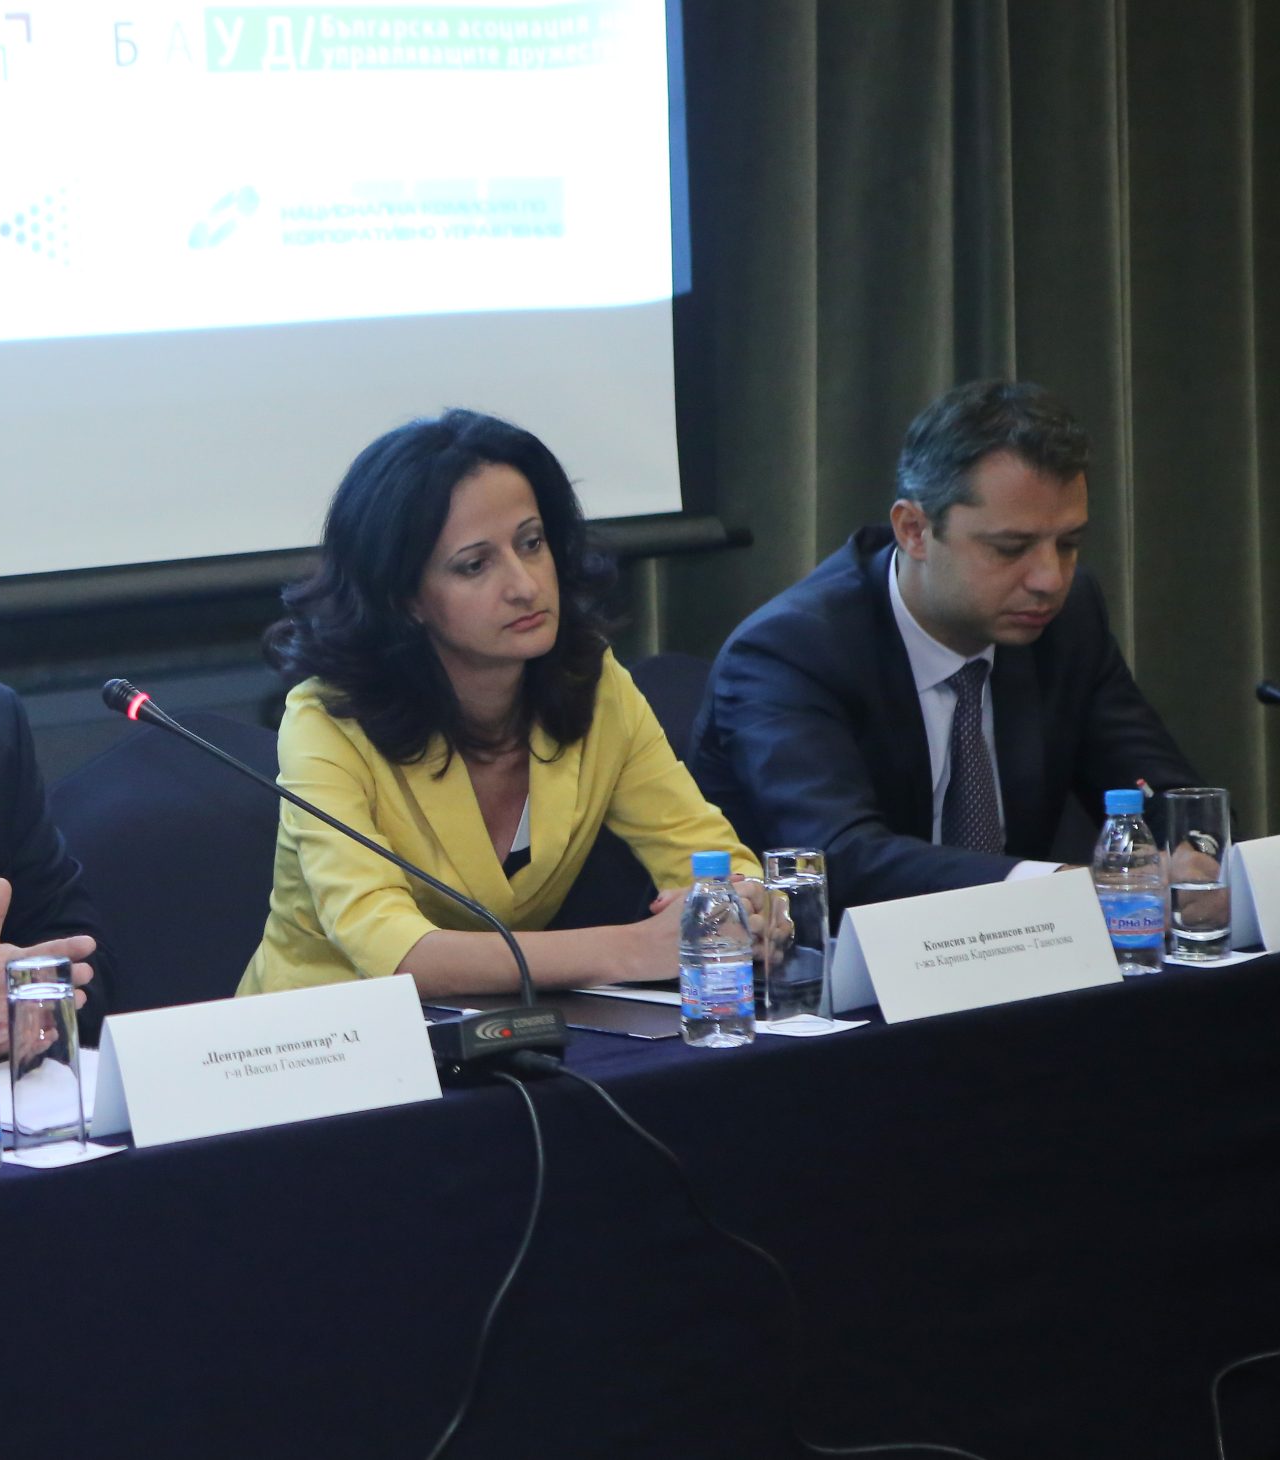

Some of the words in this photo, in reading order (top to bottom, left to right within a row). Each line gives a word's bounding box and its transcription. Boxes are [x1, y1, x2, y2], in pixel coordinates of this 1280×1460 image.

[320, 14, 450, 42] Българска
[458, 14, 588, 42] асоциация
[923, 937, 966, 952] Комисия
[968, 935, 978, 945] за
[978, 927, 1024, 945] финансов
[1024, 921, 1056, 936] надзор
[936, 951, 969, 967] Карина
[341, 1030, 361, 1044] АД
[243, 1063, 279, 1077] Васил
[279, 1052, 347, 1073] Големански
